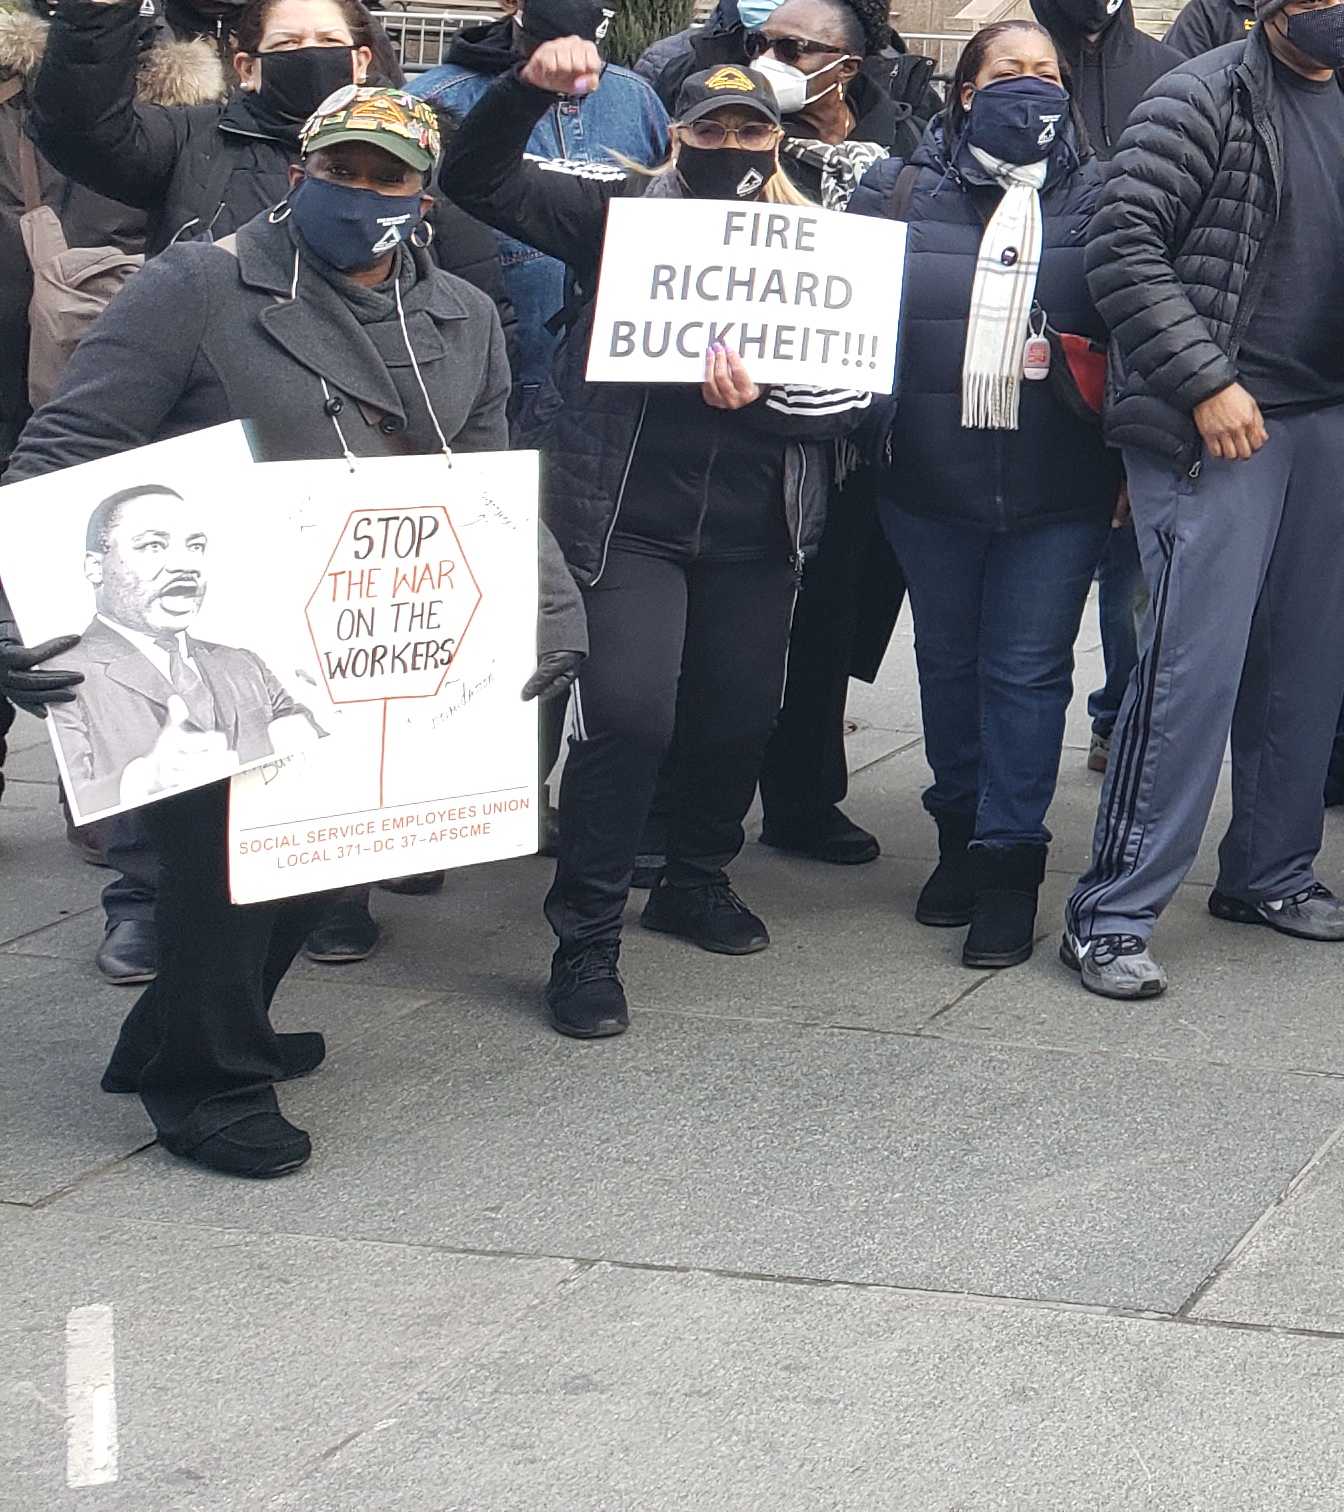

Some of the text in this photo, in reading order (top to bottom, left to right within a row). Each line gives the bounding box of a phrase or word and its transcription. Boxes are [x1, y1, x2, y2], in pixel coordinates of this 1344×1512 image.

[723, 211, 818, 252] FIRE
[649, 264, 853, 310] RICHARD
[353, 515, 439, 559] STOP
[328, 560, 455, 602] THE WAR
[337, 600, 443, 641] ON THE
[324, 638, 454, 679] WORKERS
[239, 798, 531, 855] SOCIAL SERVICE EMPLOYEES UNION
[277, 849, 331, 869] LOCAL
